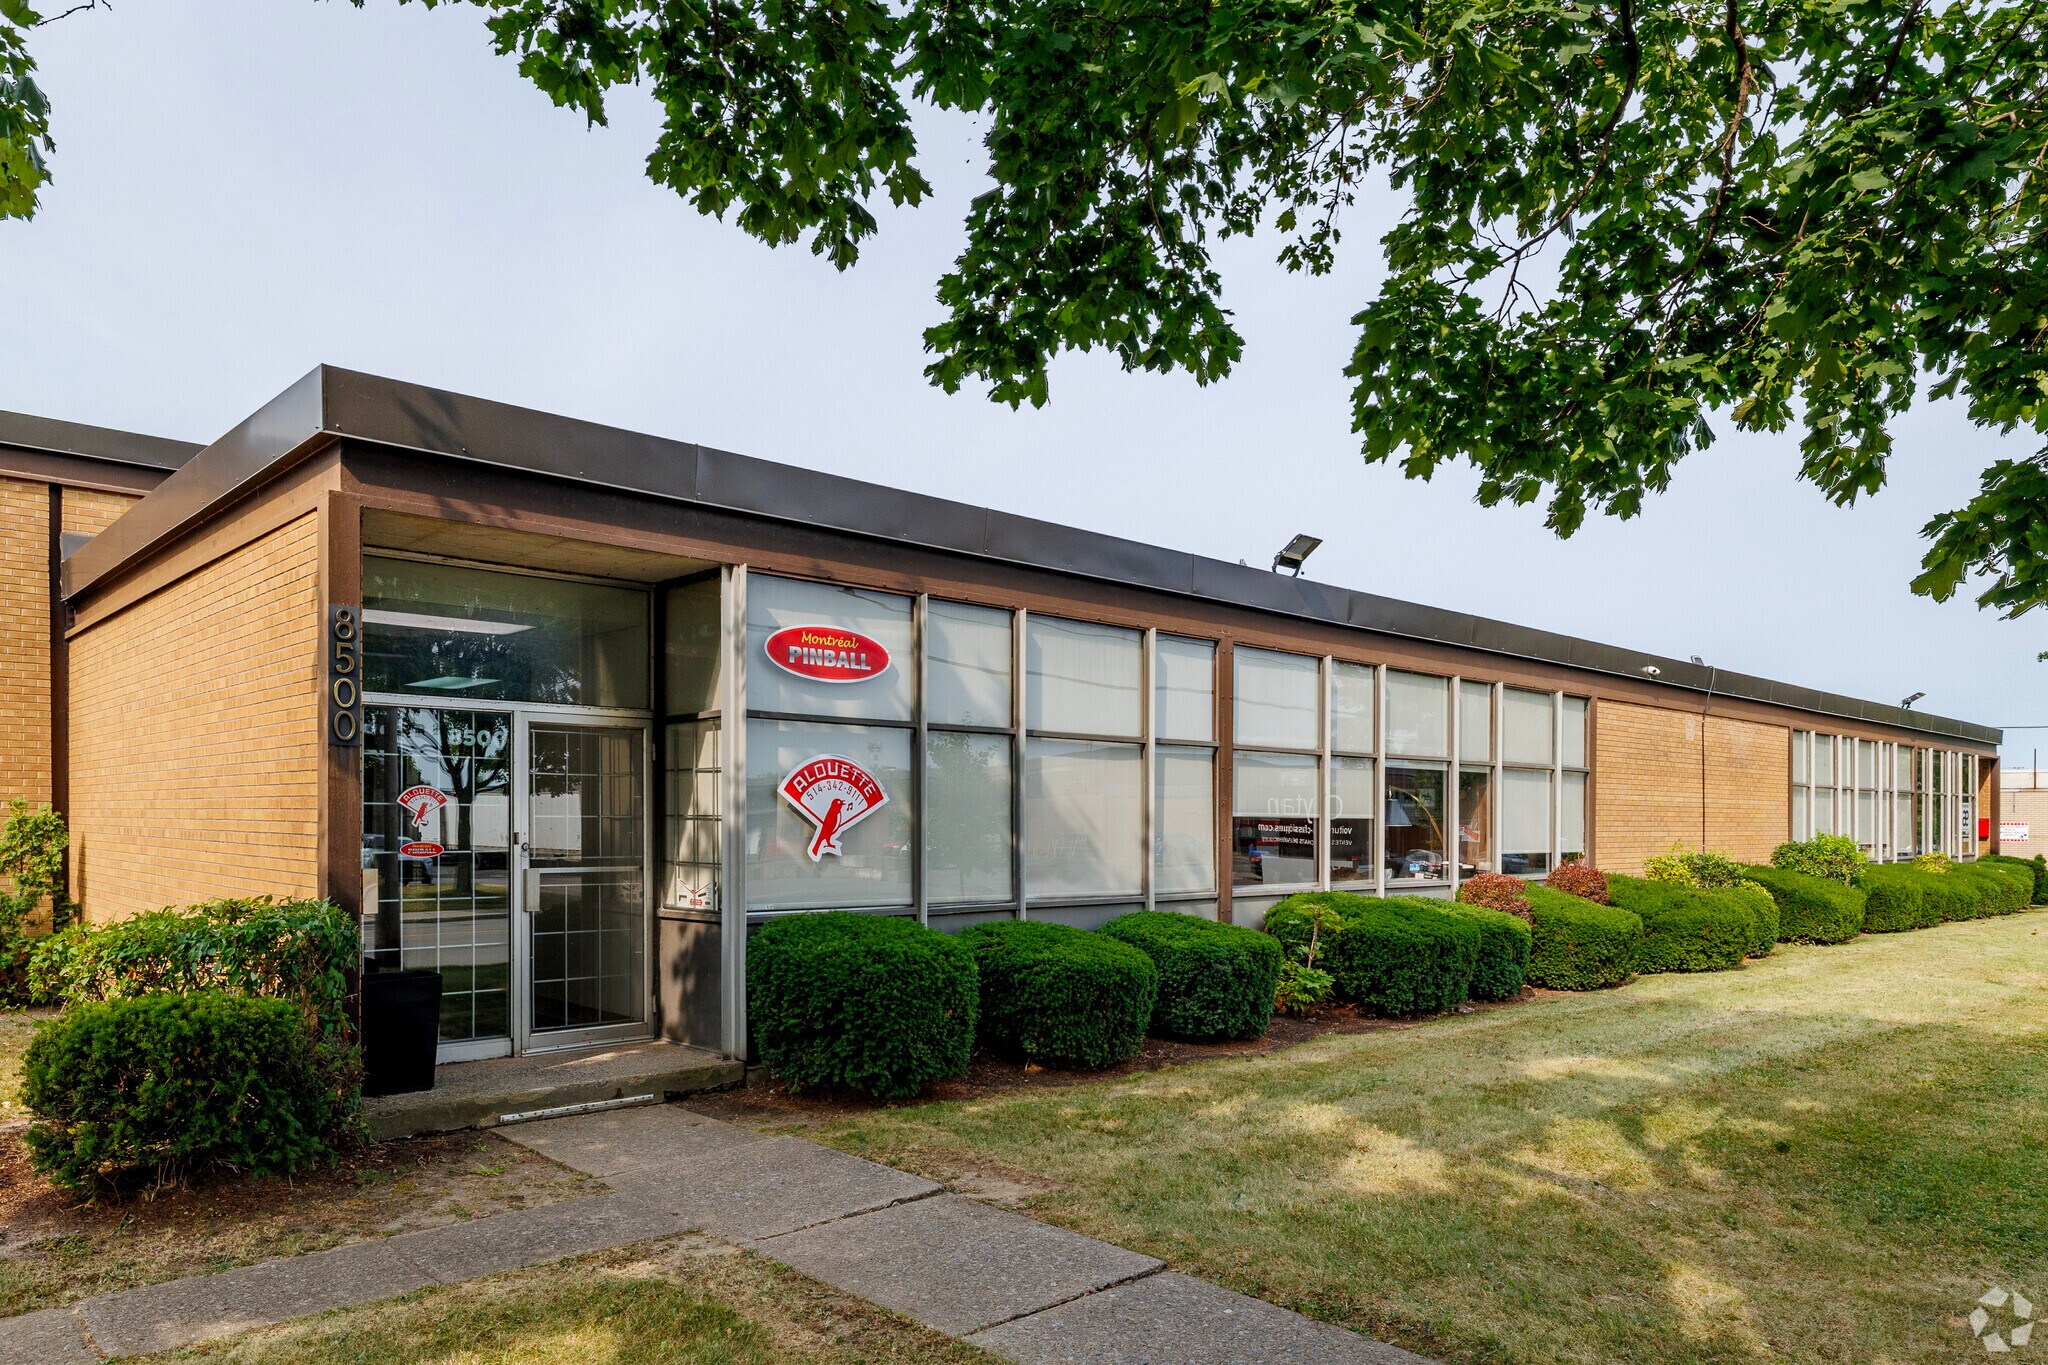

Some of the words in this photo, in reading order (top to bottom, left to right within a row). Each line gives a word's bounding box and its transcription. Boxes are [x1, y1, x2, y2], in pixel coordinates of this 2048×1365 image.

[801, 631, 859, 649] Montréal
[788, 645, 872, 671] PINBALL
[333, 608, 356, 741] 8500
[792, 763, 877, 798] ALOUETTE
[806, 781, 865, 805] 514-342-9111
[403, 788, 443, 802] ALOUETTE
